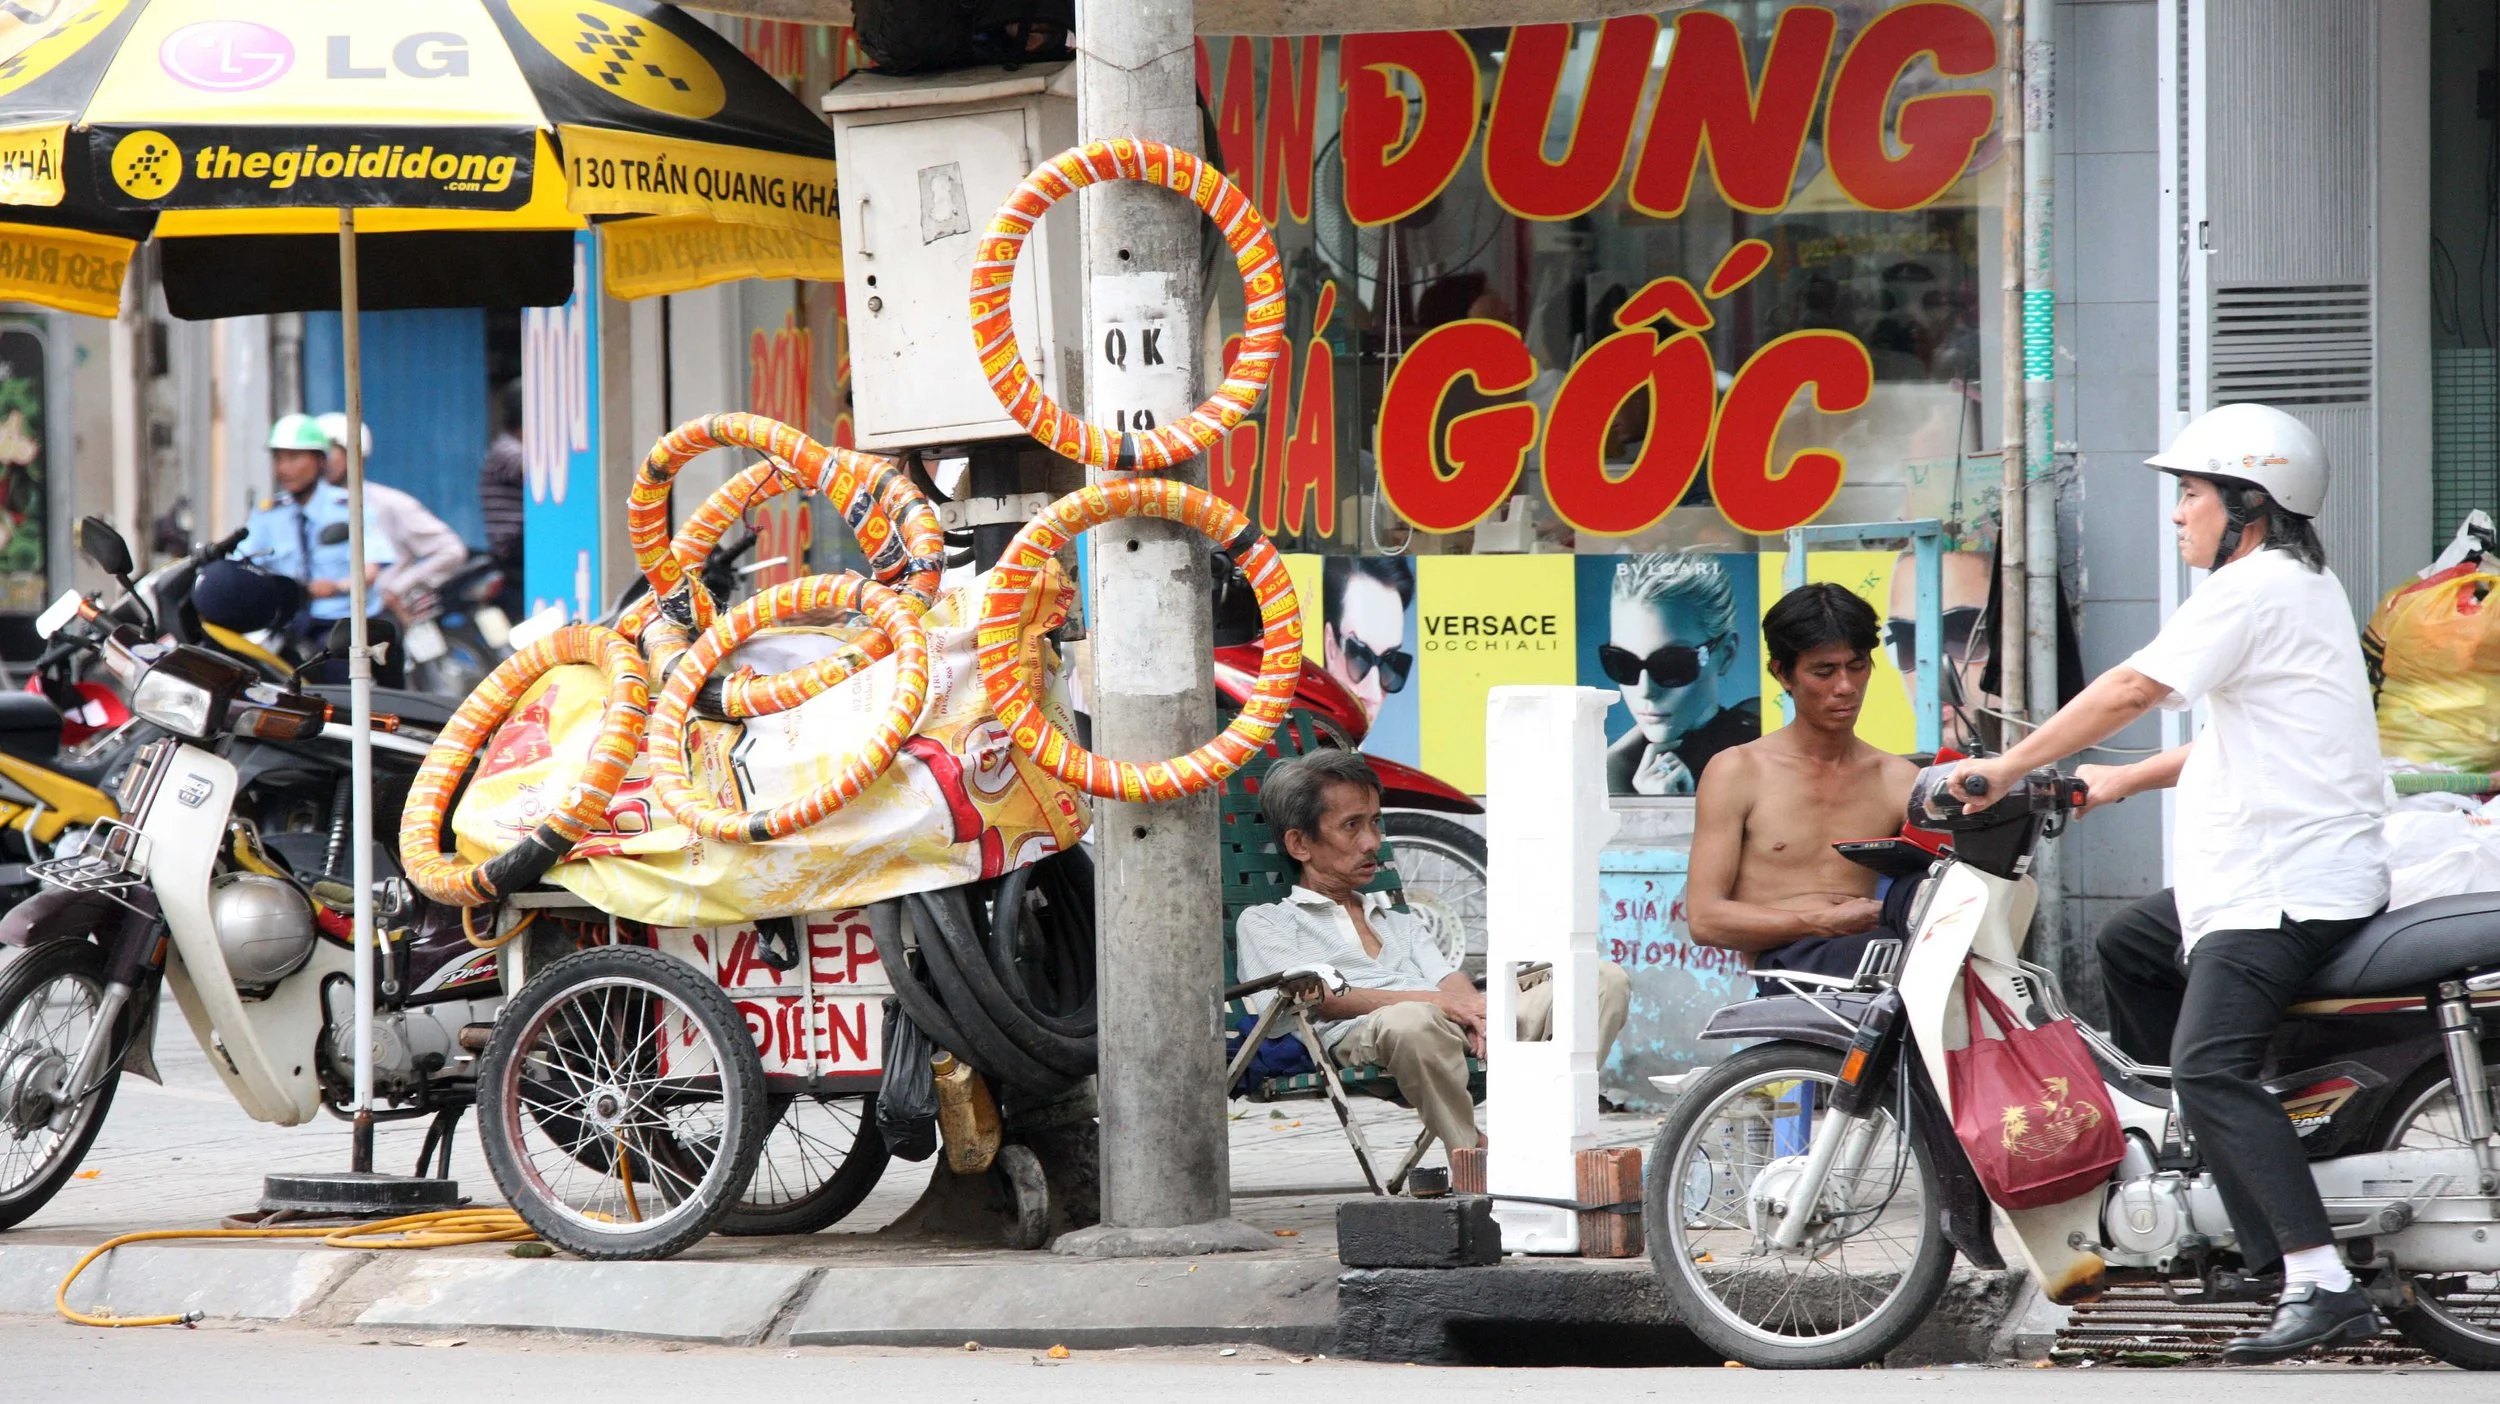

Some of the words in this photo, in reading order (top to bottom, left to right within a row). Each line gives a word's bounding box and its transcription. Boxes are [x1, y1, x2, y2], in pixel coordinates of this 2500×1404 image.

[325, 31, 470, 79] LG
[195, 145, 516, 192] thegioididong
[573, 157, 615, 188] 130
[621, 152, 688, 195] TRẦN
[694, 166, 786, 209] QUANG
[1377, 238, 1875, 537] GỐC
[1616, 561, 1720, 577] BVLGARI
[1424, 615, 1557, 636] VERSACE
[1424, 639, 1558, 652] OCCHIALI
[441, 963, 499, 984] Drea
